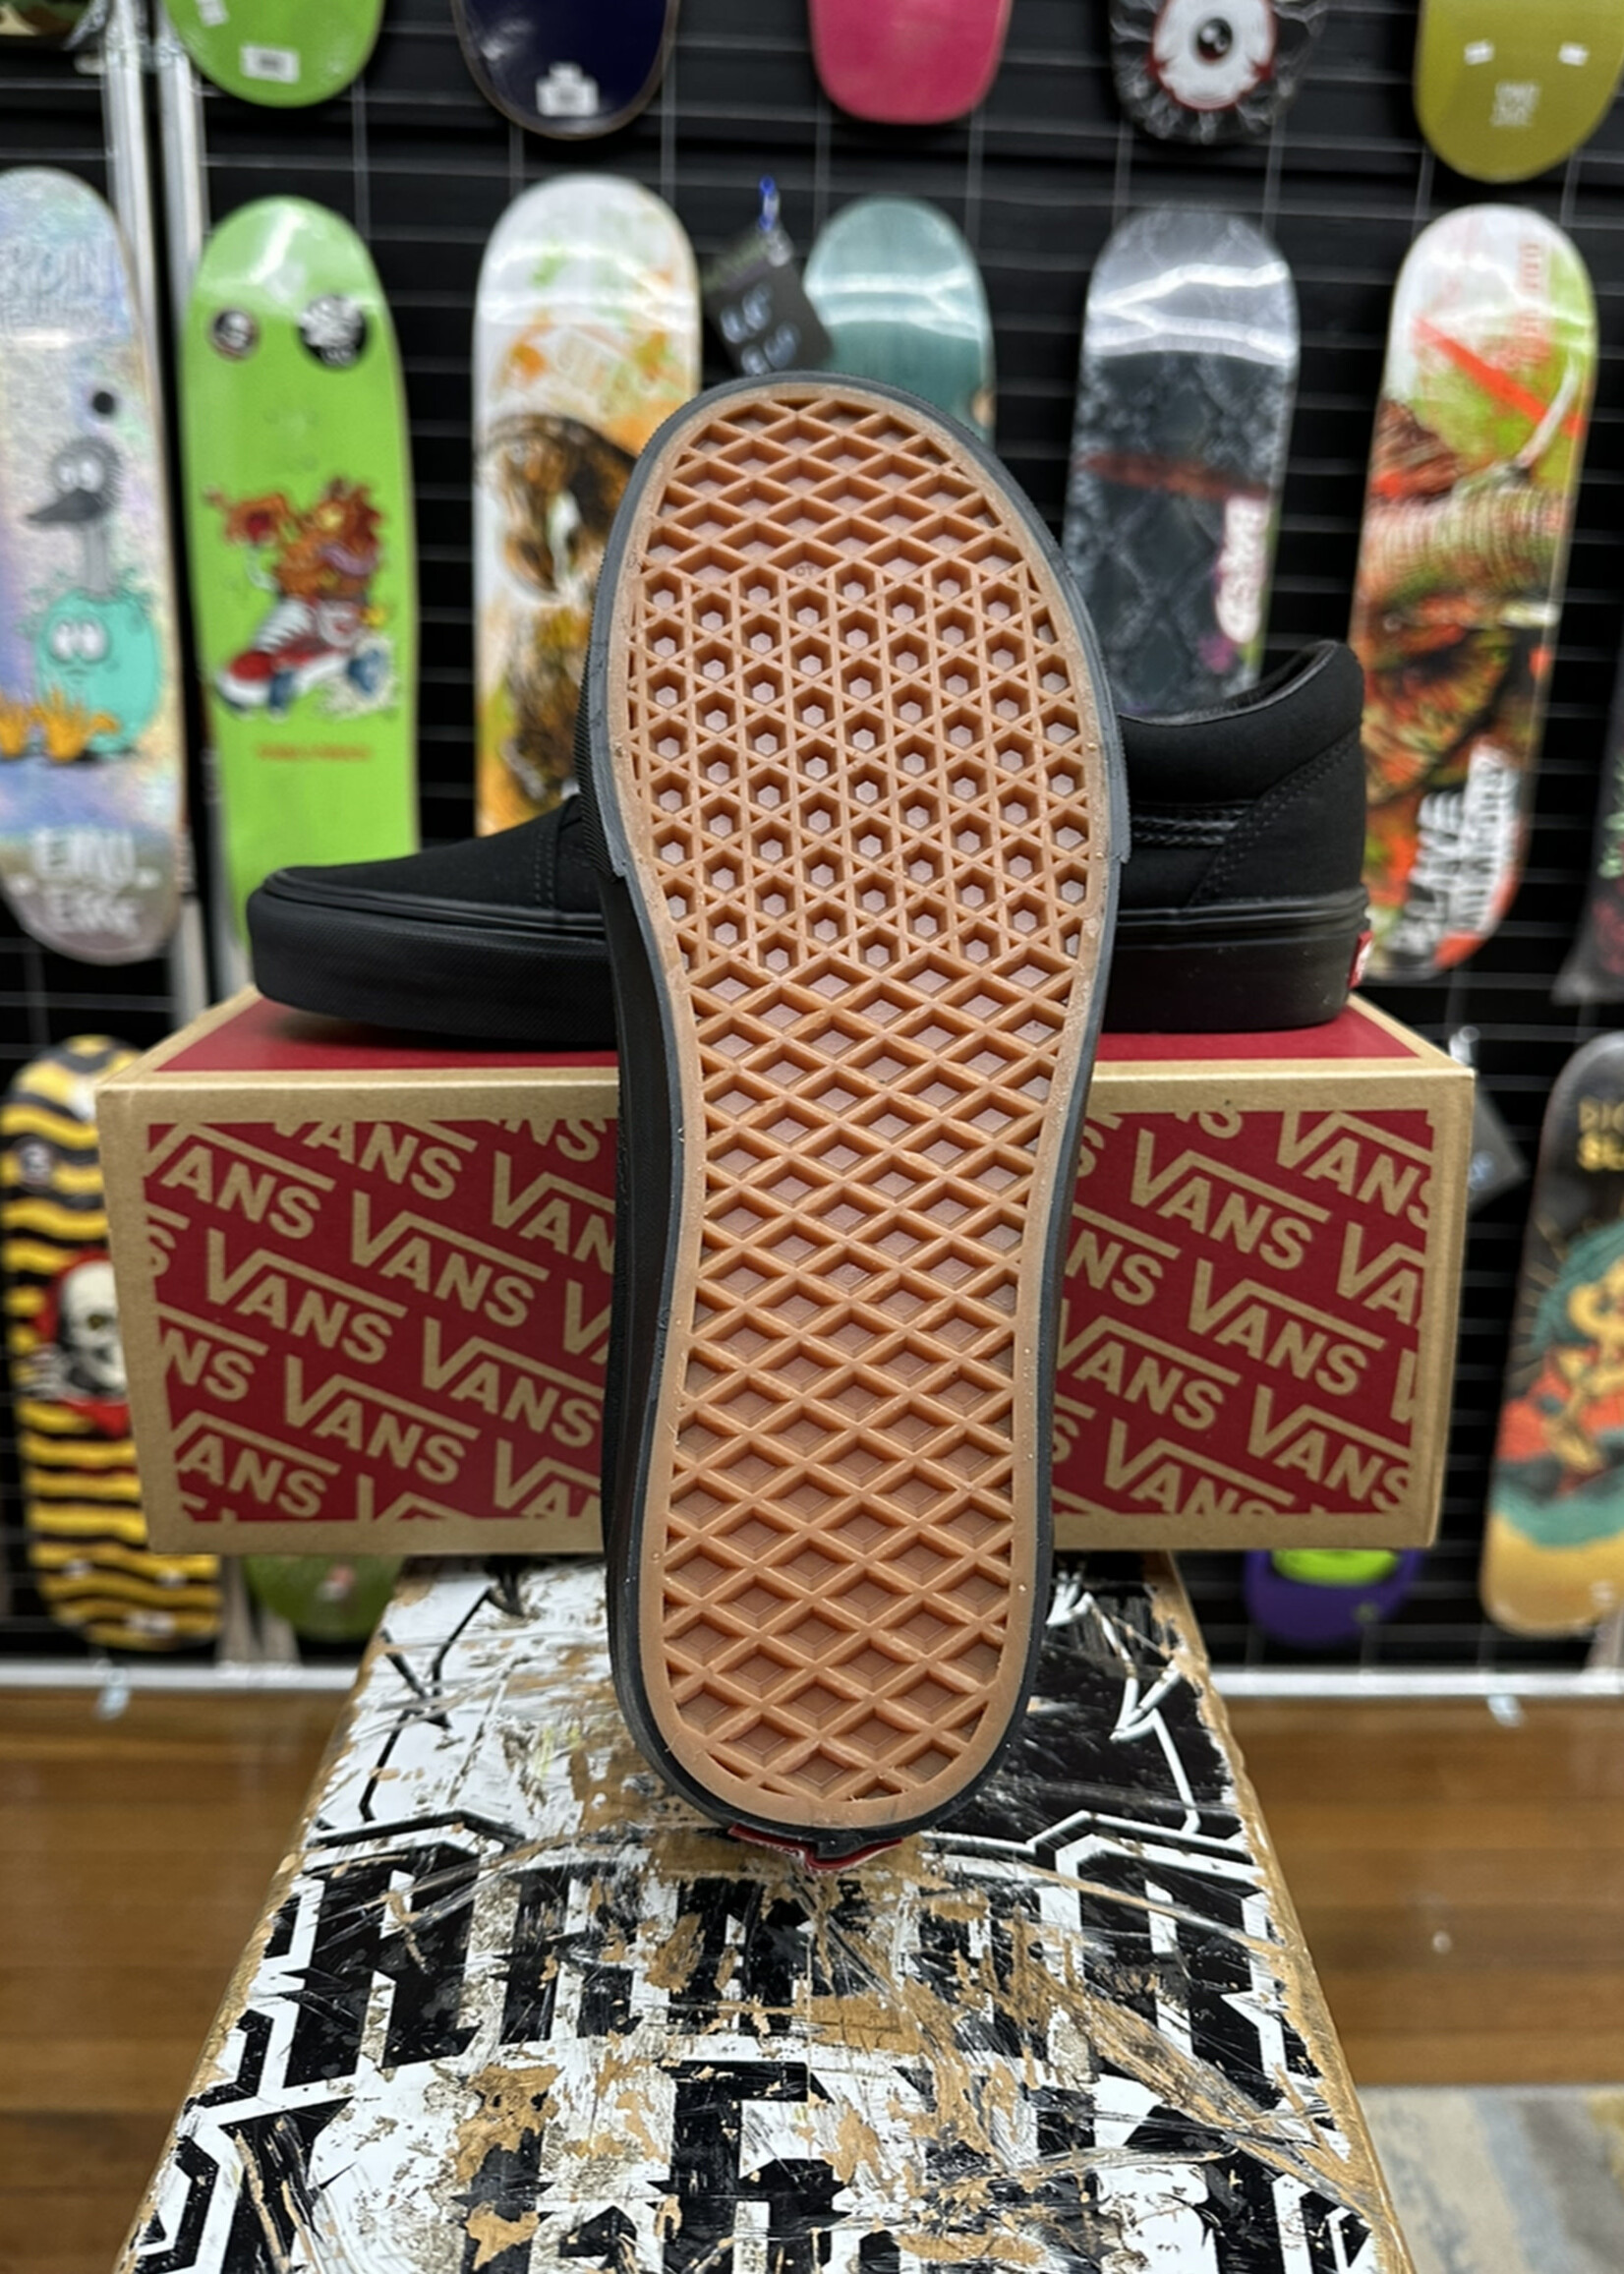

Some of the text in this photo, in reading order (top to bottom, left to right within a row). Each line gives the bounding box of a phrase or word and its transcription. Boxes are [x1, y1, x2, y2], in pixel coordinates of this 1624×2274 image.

[271, 1120, 478, 1200] ANS
[1131, 1128, 1331, 1270] VANS
[350, 1190, 549, 1327] VANS
[1188, 1257, 1387, 1395] VANS
[207, 1227, 408, 1364] VANS
[423, 1316, 607, 1448] VANS
[285, 1354, 479, 1485] VANS
[1104, 1418, 1295, 1514] VAN
